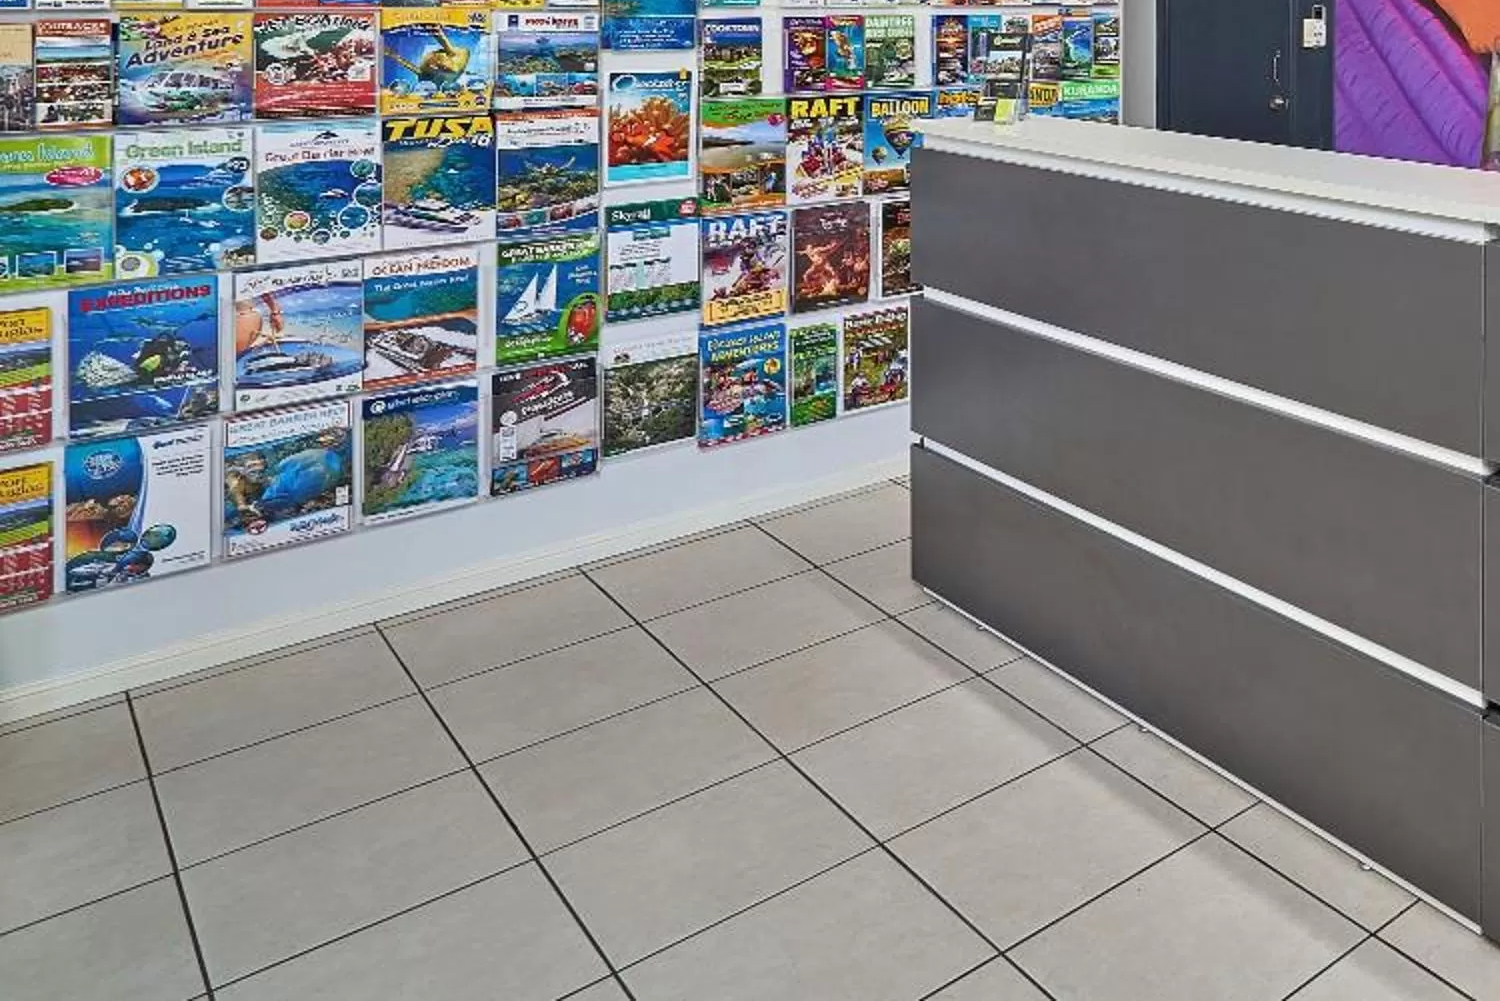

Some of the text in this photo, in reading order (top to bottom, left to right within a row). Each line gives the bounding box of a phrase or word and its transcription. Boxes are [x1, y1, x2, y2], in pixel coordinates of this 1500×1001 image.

[126, 35, 244, 69] Adventure
[790, 97, 860, 118] RAFT
[871, 100, 930, 117] BALLOON
[384, 116, 494, 141] TUSA
